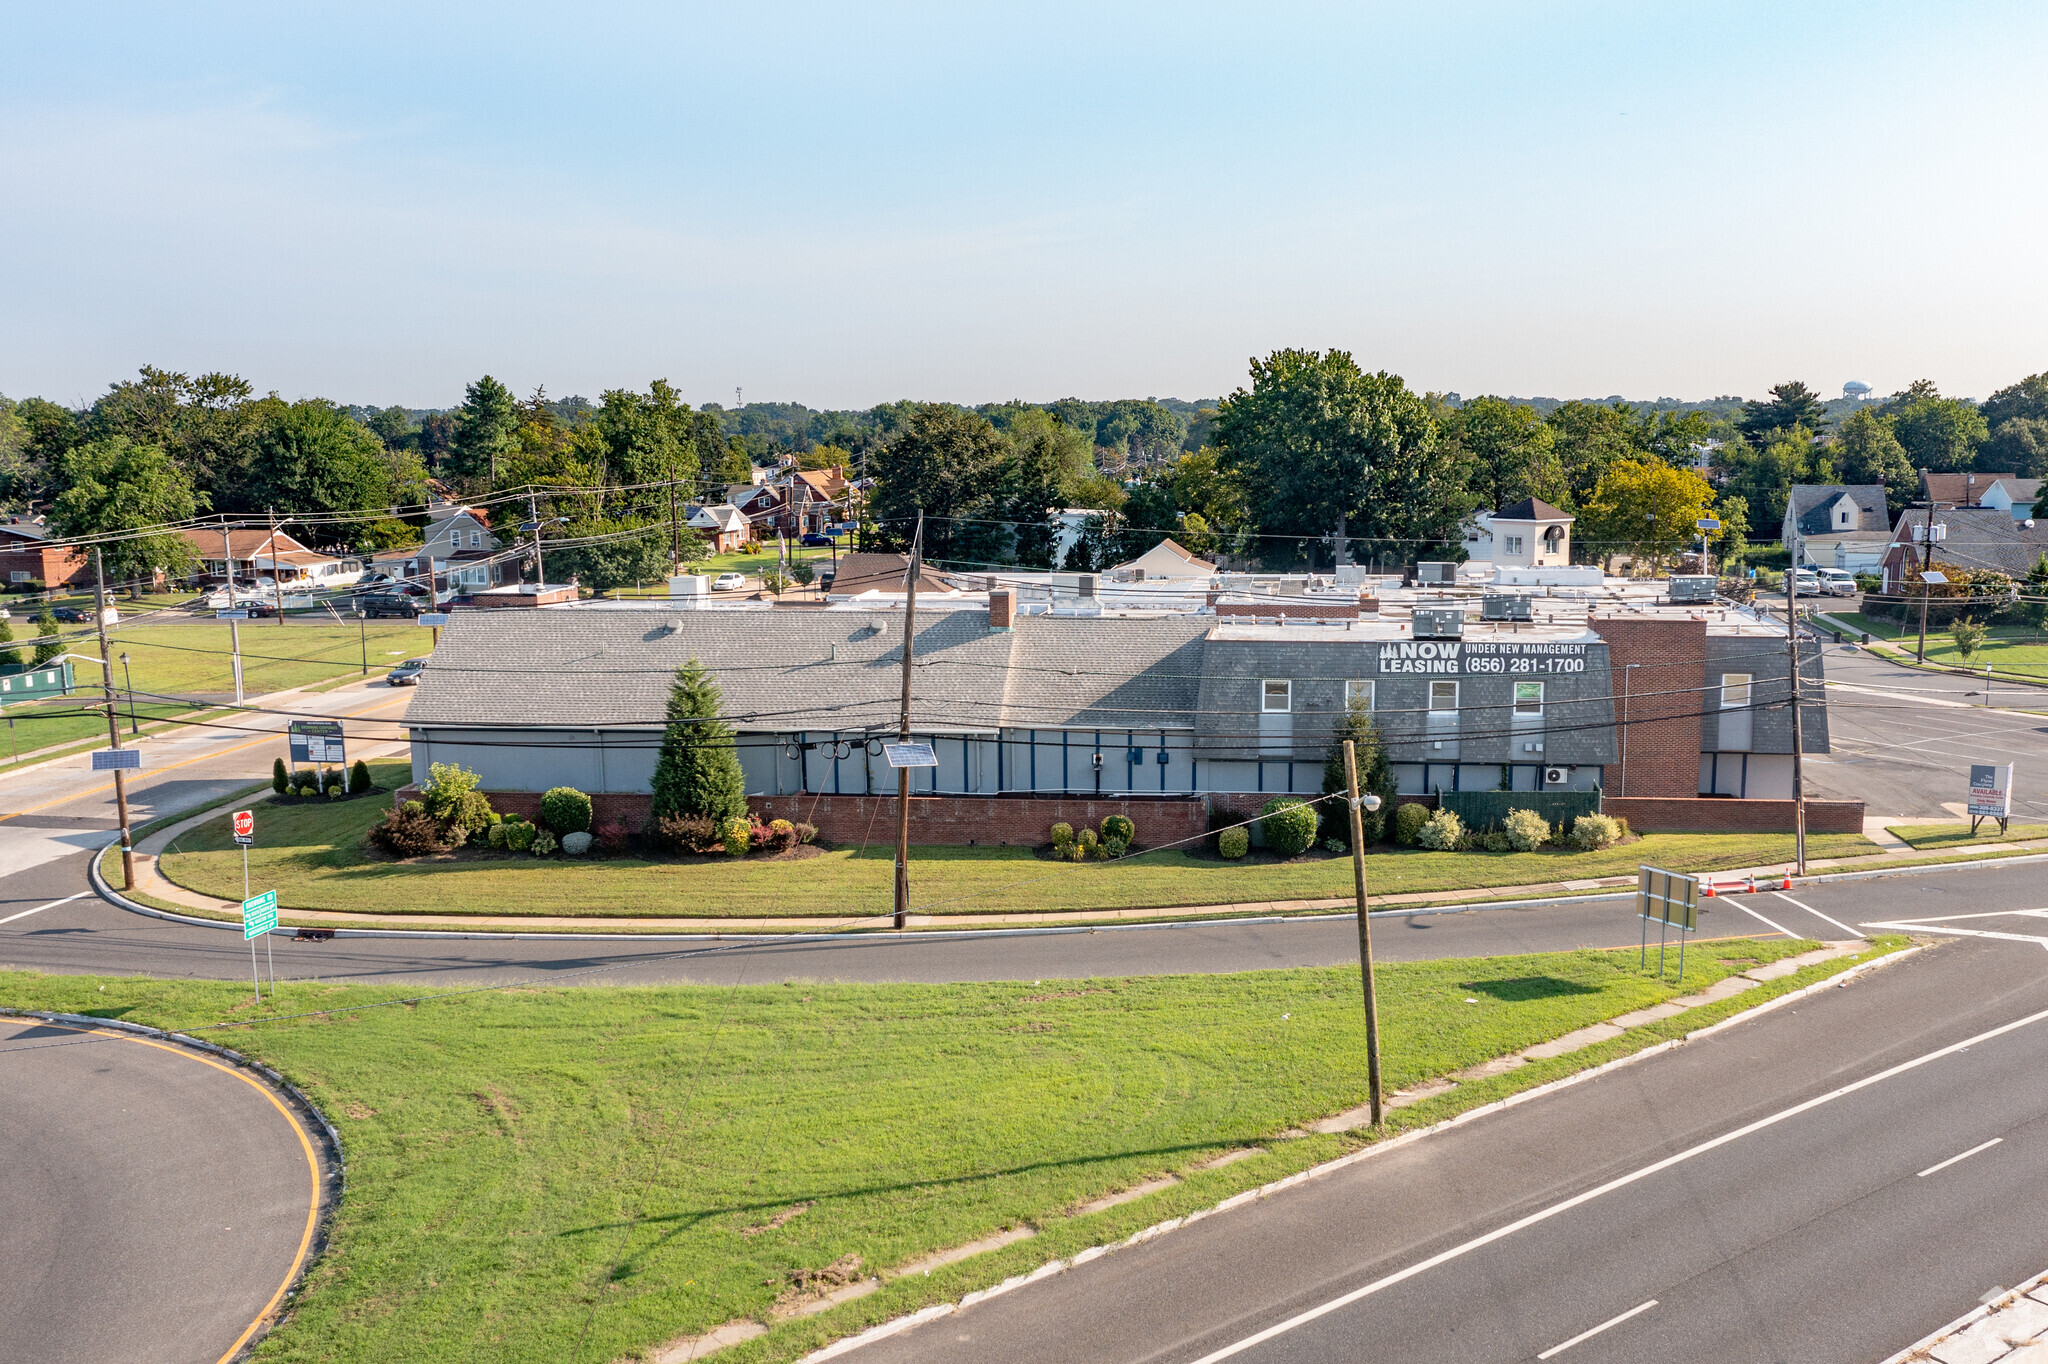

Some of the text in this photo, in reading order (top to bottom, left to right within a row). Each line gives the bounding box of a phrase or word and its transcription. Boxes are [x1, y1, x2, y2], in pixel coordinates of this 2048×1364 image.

[1400, 643, 1461, 659] NOW
[1465, 644, 1587, 655] UNDER NEW MANAGEMENT
[1380, 659, 1459, 673] LEASING
[1465, 656, 1585, 673] (856) 281-1700
[236, 818, 252, 829] STOP
